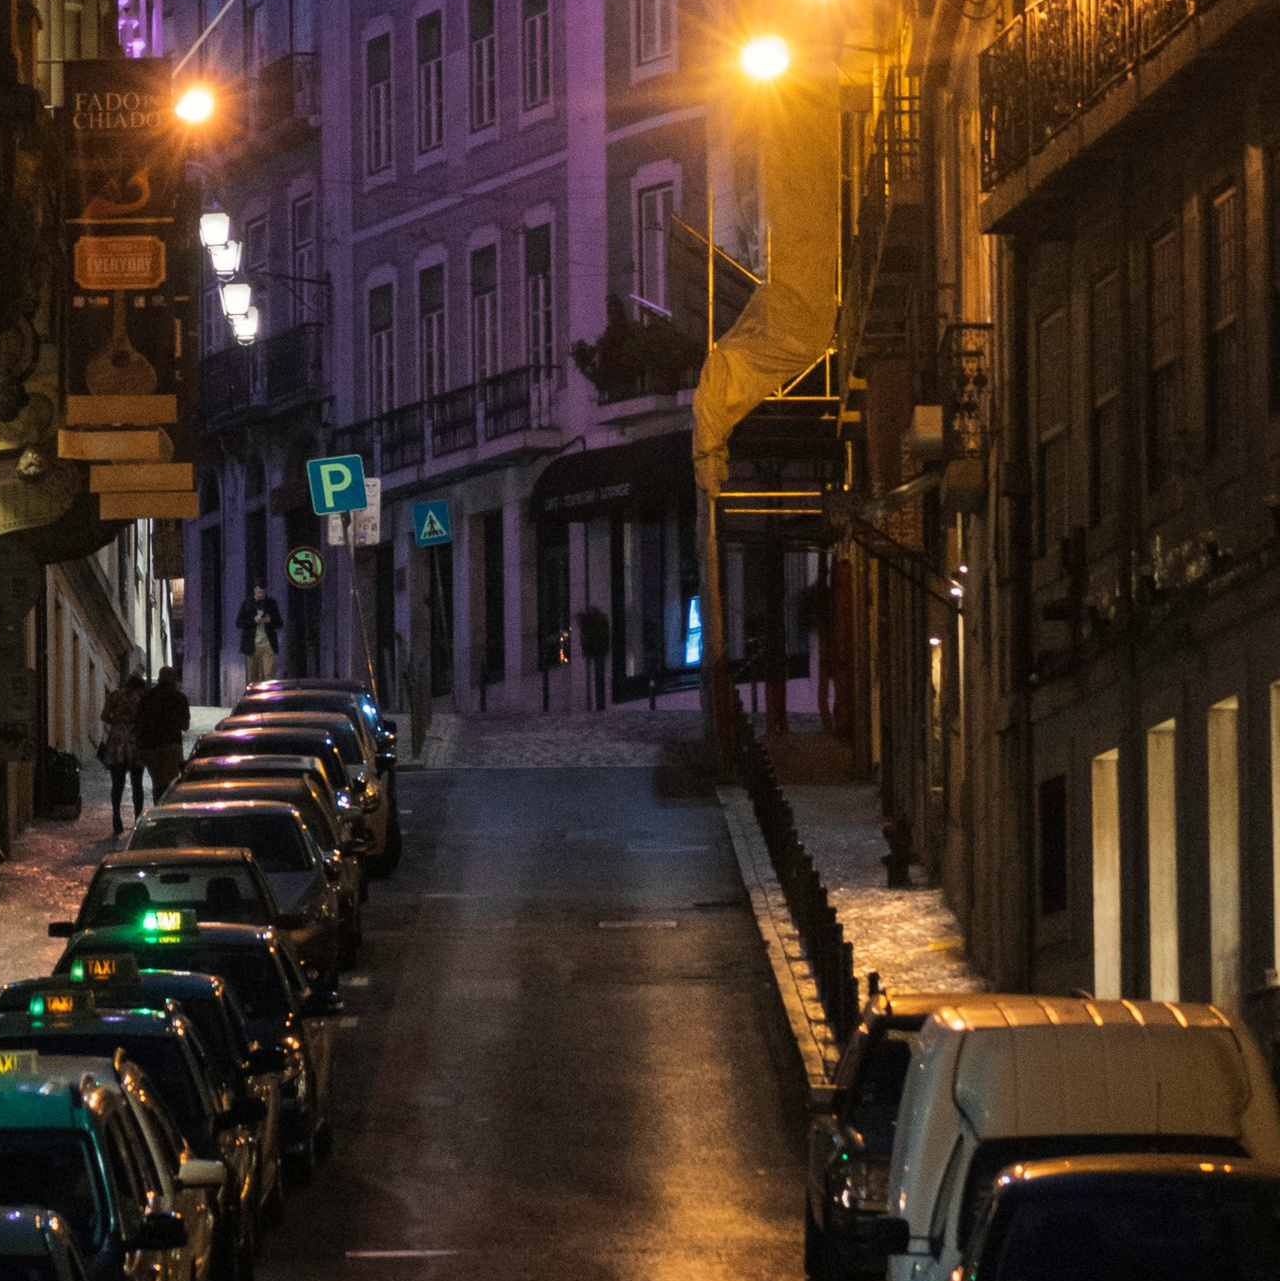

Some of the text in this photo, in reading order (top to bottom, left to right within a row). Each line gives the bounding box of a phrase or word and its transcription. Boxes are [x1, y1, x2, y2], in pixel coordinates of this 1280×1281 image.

[74, 92, 141, 111] FADO
[72, 111, 162, 131] CHIADO
[319, 462, 352, 508] P
[156, 911, 181, 928] TAXI
[88, 960, 116, 975] TAXI
[46, 996, 74, 1011] TAXI
